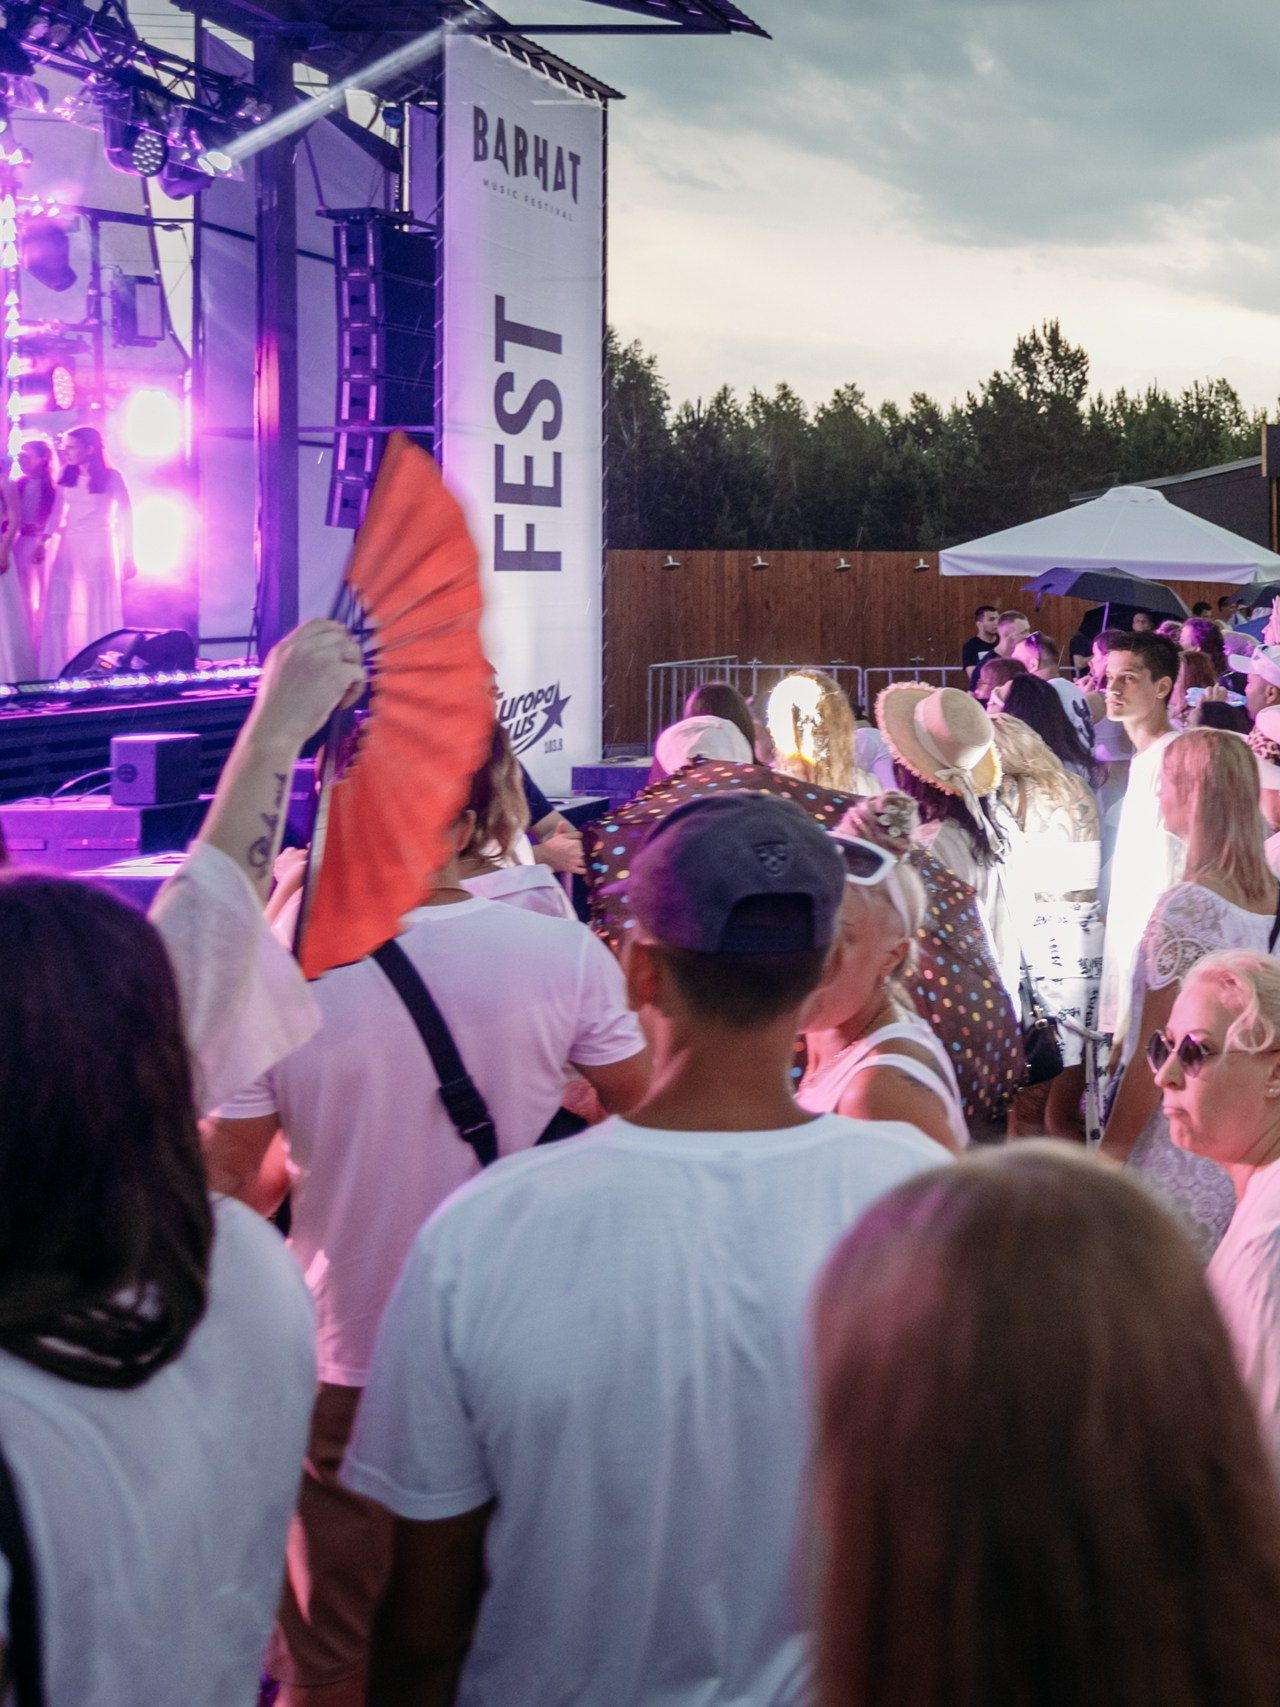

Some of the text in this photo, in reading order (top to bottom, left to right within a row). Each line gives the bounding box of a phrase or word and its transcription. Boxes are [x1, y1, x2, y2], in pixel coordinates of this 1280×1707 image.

[473, 105, 581, 205] BARHAT
[483, 178, 573, 222] MUSIC FESTIVAL
[494, 294, 563, 572] FEST
